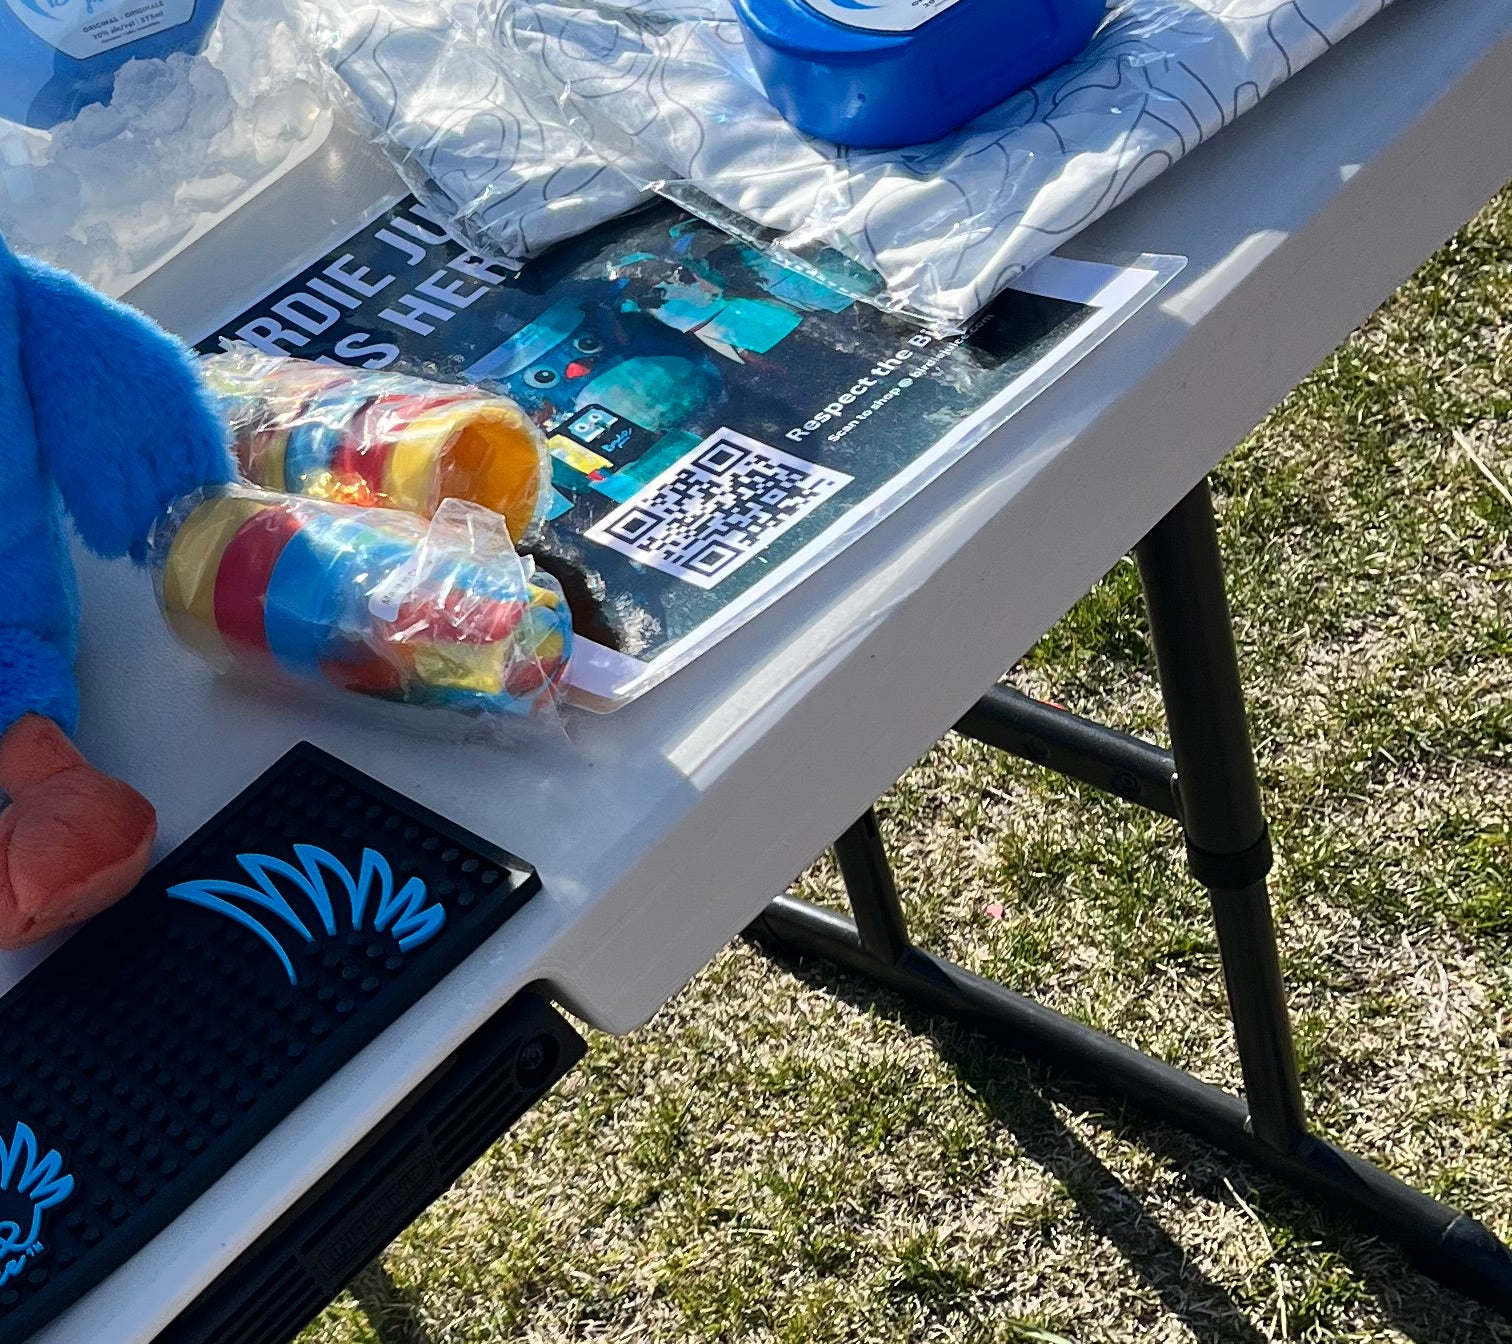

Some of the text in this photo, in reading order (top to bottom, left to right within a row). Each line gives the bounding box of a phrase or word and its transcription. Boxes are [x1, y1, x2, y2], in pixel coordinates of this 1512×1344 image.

[234, 203, 452, 358] RDIE JU
[377, 247, 526, 337] HER
[786, 327, 942, 443] Respect the Bi
[827, 416, 860, 443] Scan
[856, 408, 874, 422] to
[871, 386, 902, 411] shop
